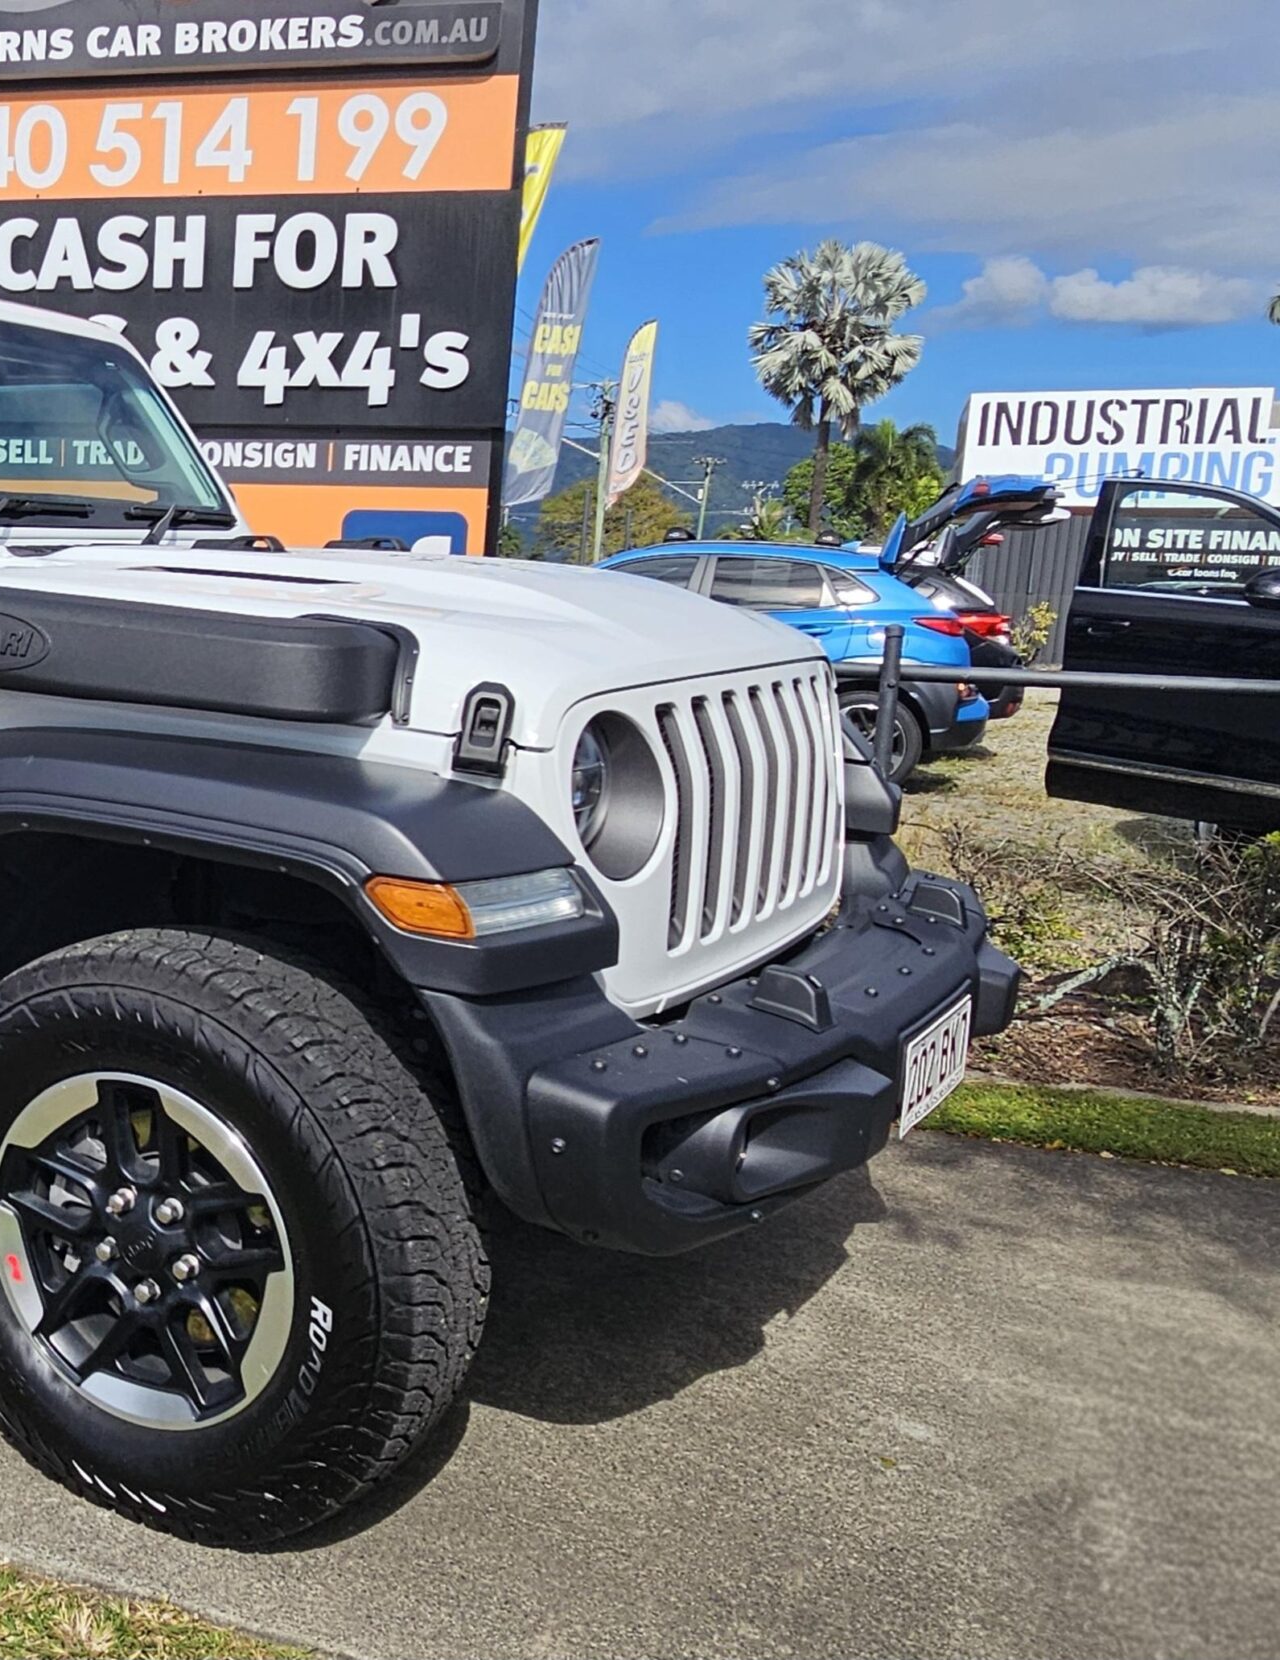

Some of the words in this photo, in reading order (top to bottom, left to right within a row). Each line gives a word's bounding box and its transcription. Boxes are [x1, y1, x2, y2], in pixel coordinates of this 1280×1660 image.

[86, 24, 162, 58] CAR
[89, 97, 252, 187] 514
[285, 92, 448, 182] 199
[232, 213, 400, 289] FOR
[151, 317, 215, 387] &
[977, 398, 1267, 447] INDUSTRIAL
[72, 440, 145, 465] TRAD
[198, 442, 317, 468] ONSIGN
[344, 444, 472, 472] FINANCE
[1131, 552, 1158, 562] SELL
[1164, 553, 1201, 563] TRADE
[1207, 554, 1260, 565] CONSIGN
[1145, 528, 1205, 549] SITE
